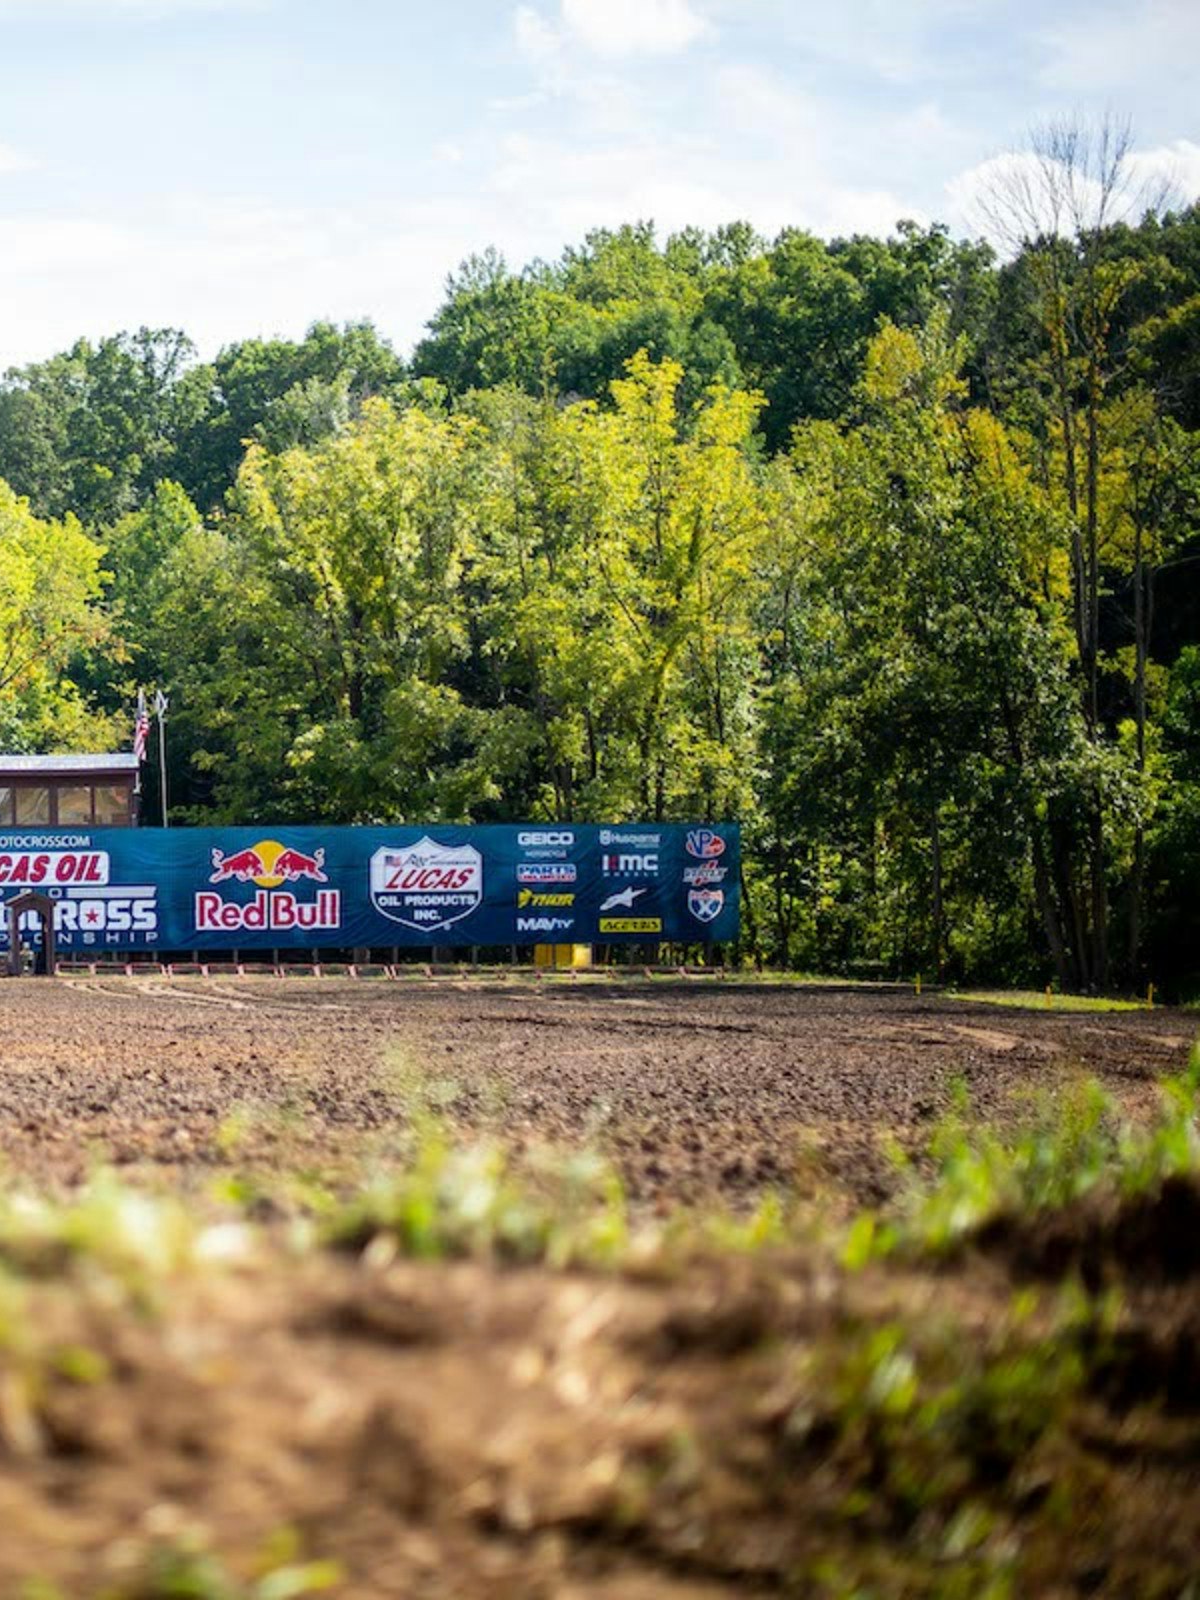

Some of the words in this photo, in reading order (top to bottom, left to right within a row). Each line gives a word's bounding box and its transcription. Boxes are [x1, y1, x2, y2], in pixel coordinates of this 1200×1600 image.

[518, 832, 574, 845] GEICO
[55, 854, 102, 881] OIL
[385, 868, 475, 889] LUCAS
[378, 896, 401, 906] OIL
[404, 895, 476, 906] PRODUCTS
[531, 893, 575, 906] THOR
[197, 892, 266, 929] Red
[270, 891, 339, 929] Bull
[413, 909, 442, 921] INC.
